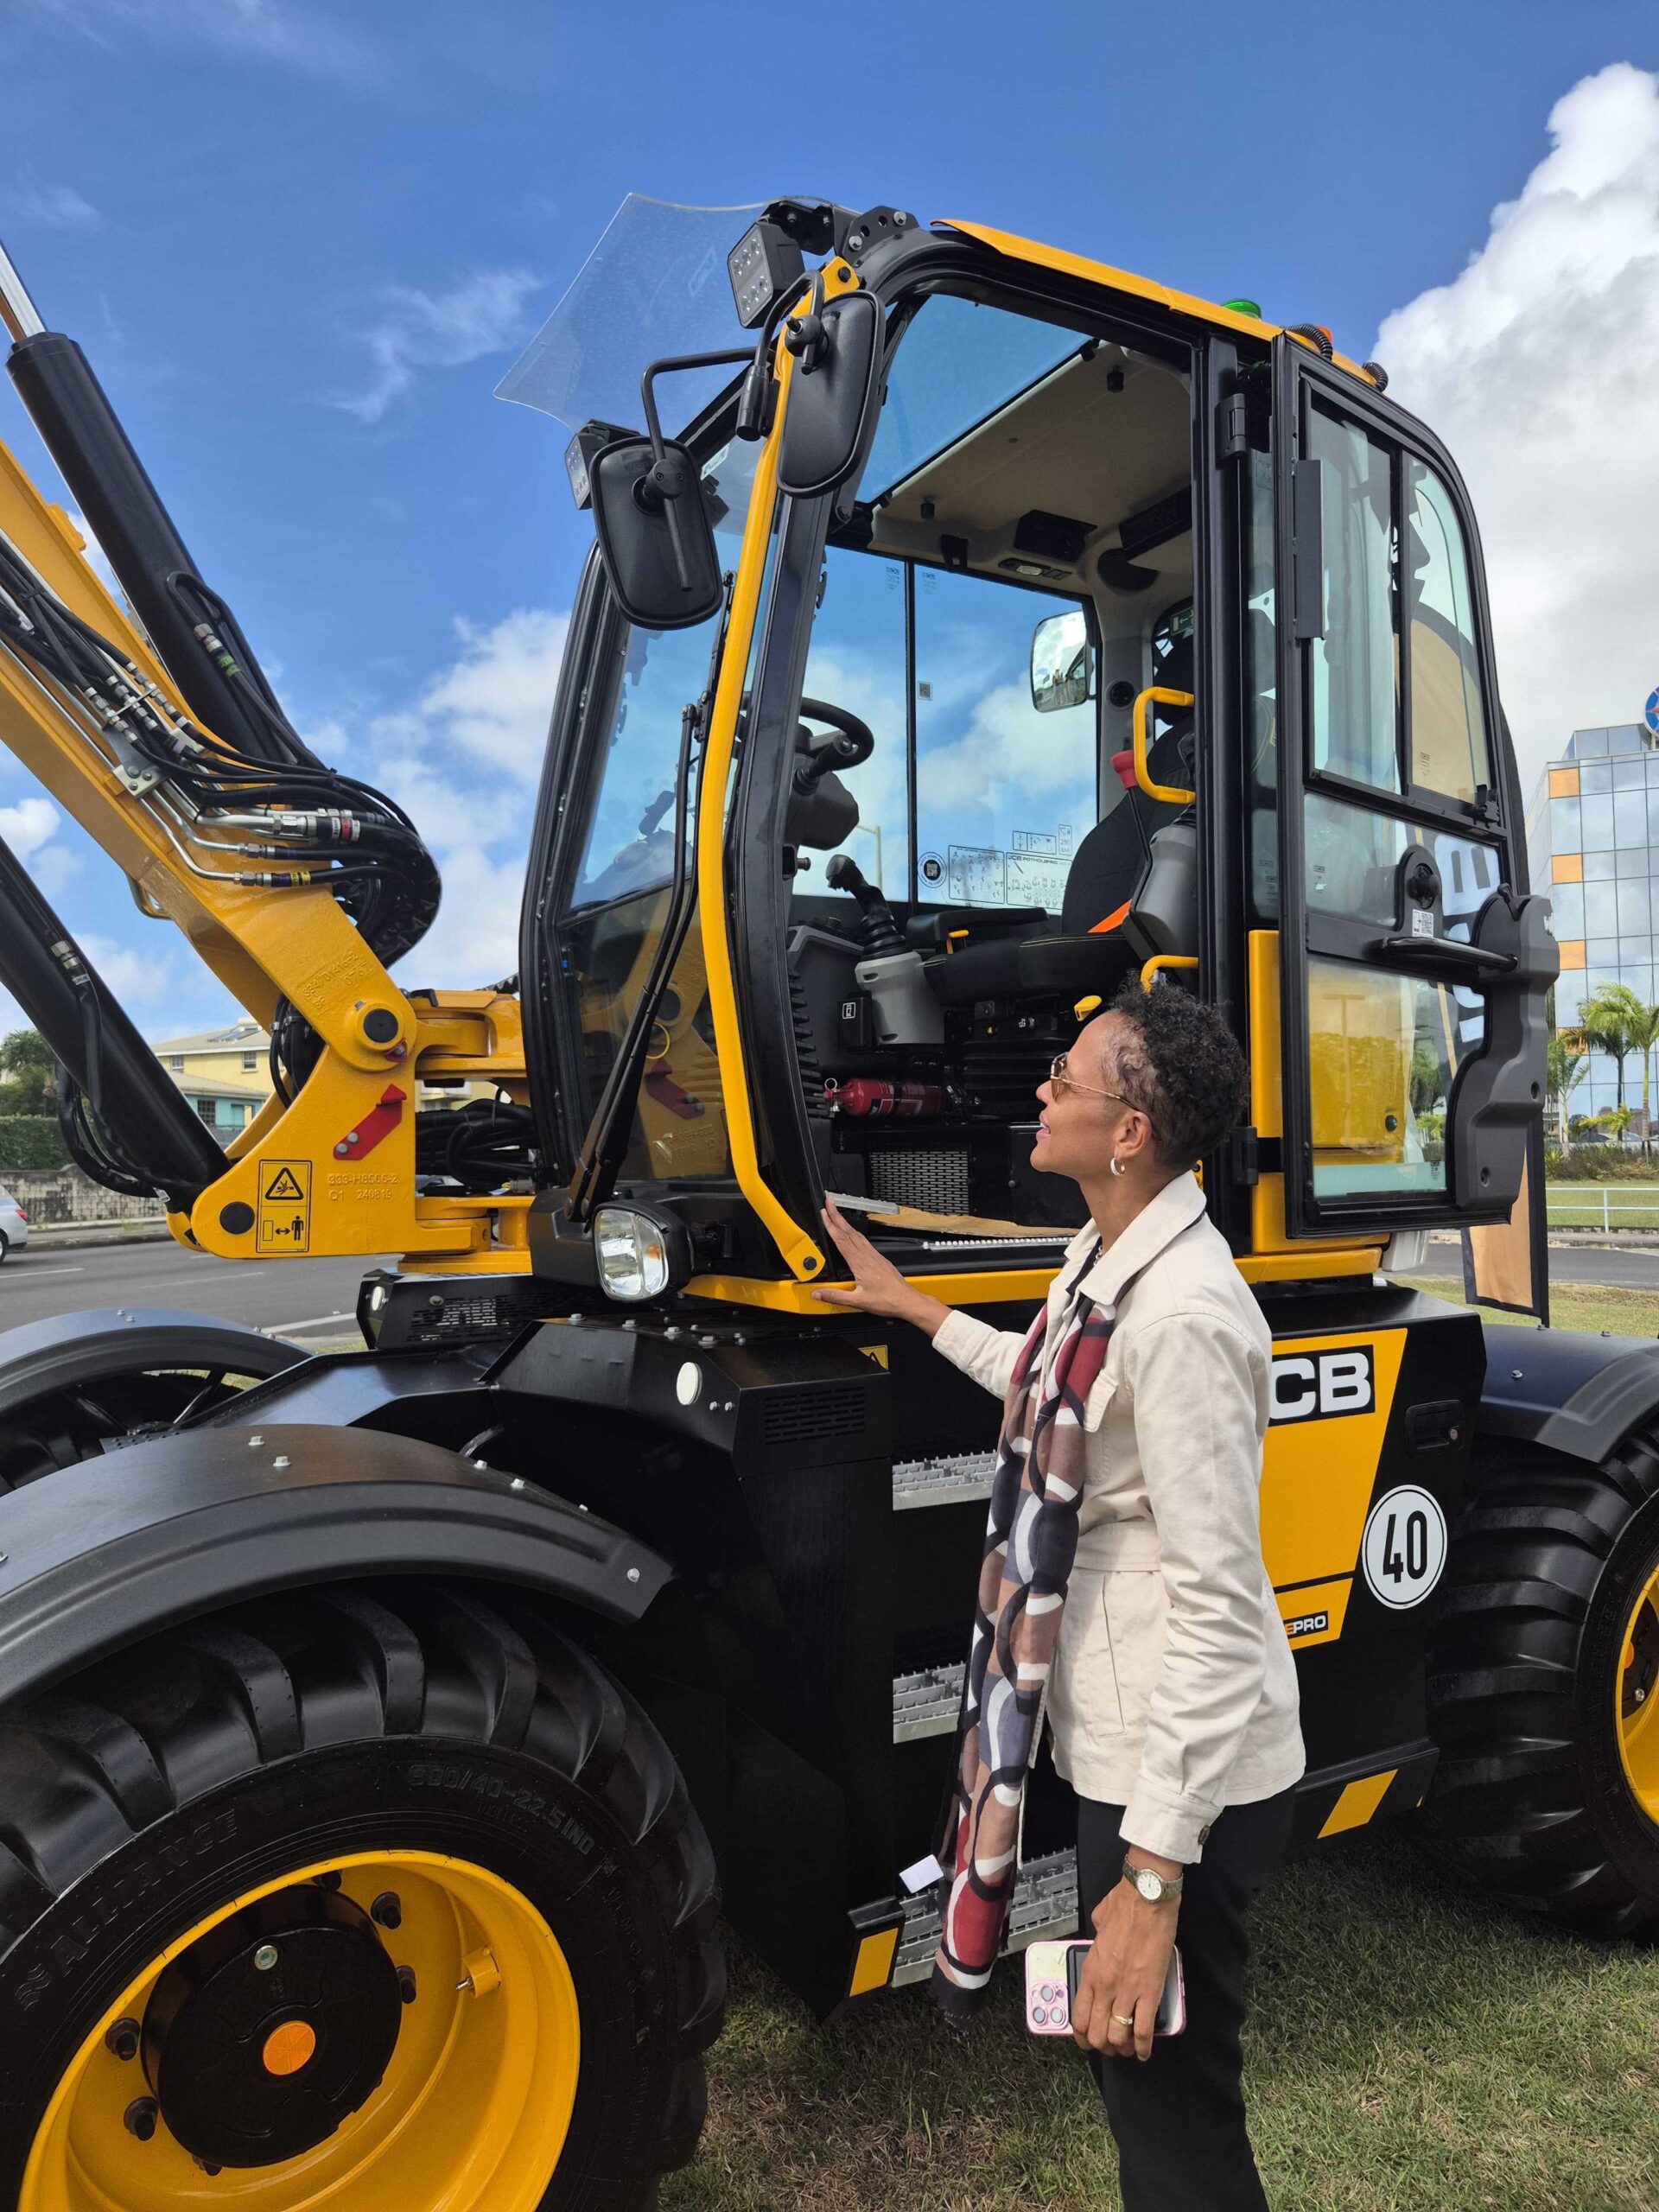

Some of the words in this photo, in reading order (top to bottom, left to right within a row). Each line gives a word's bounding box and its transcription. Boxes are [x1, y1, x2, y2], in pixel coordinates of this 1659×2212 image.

[1269, 1351, 1372, 1420] CB
[1382, 1510, 1428, 1584] 40
[1284, 1615, 1326, 1636] EPRO
